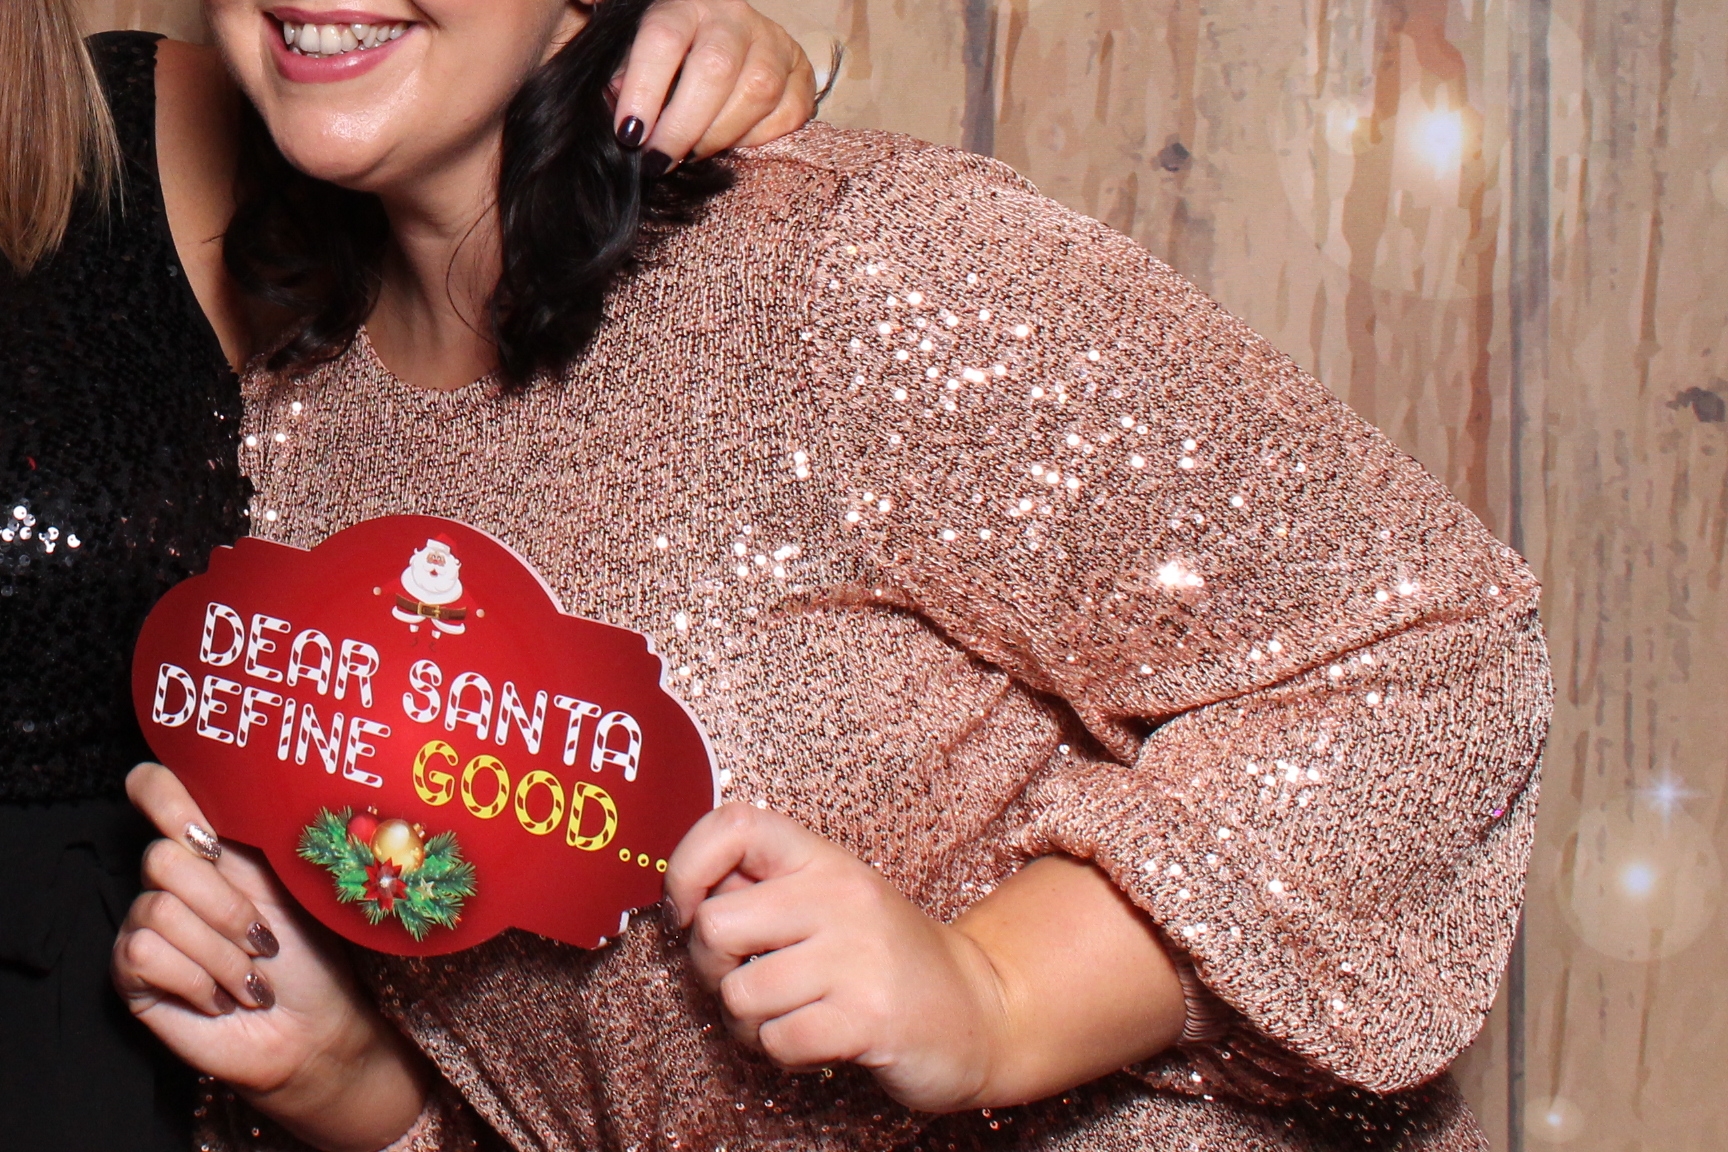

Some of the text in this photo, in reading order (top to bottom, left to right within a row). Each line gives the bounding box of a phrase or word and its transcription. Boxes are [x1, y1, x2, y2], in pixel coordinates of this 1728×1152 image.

[151, 662, 392, 789] DEFINE
[198, 601, 643, 783] DEAR SANTA
